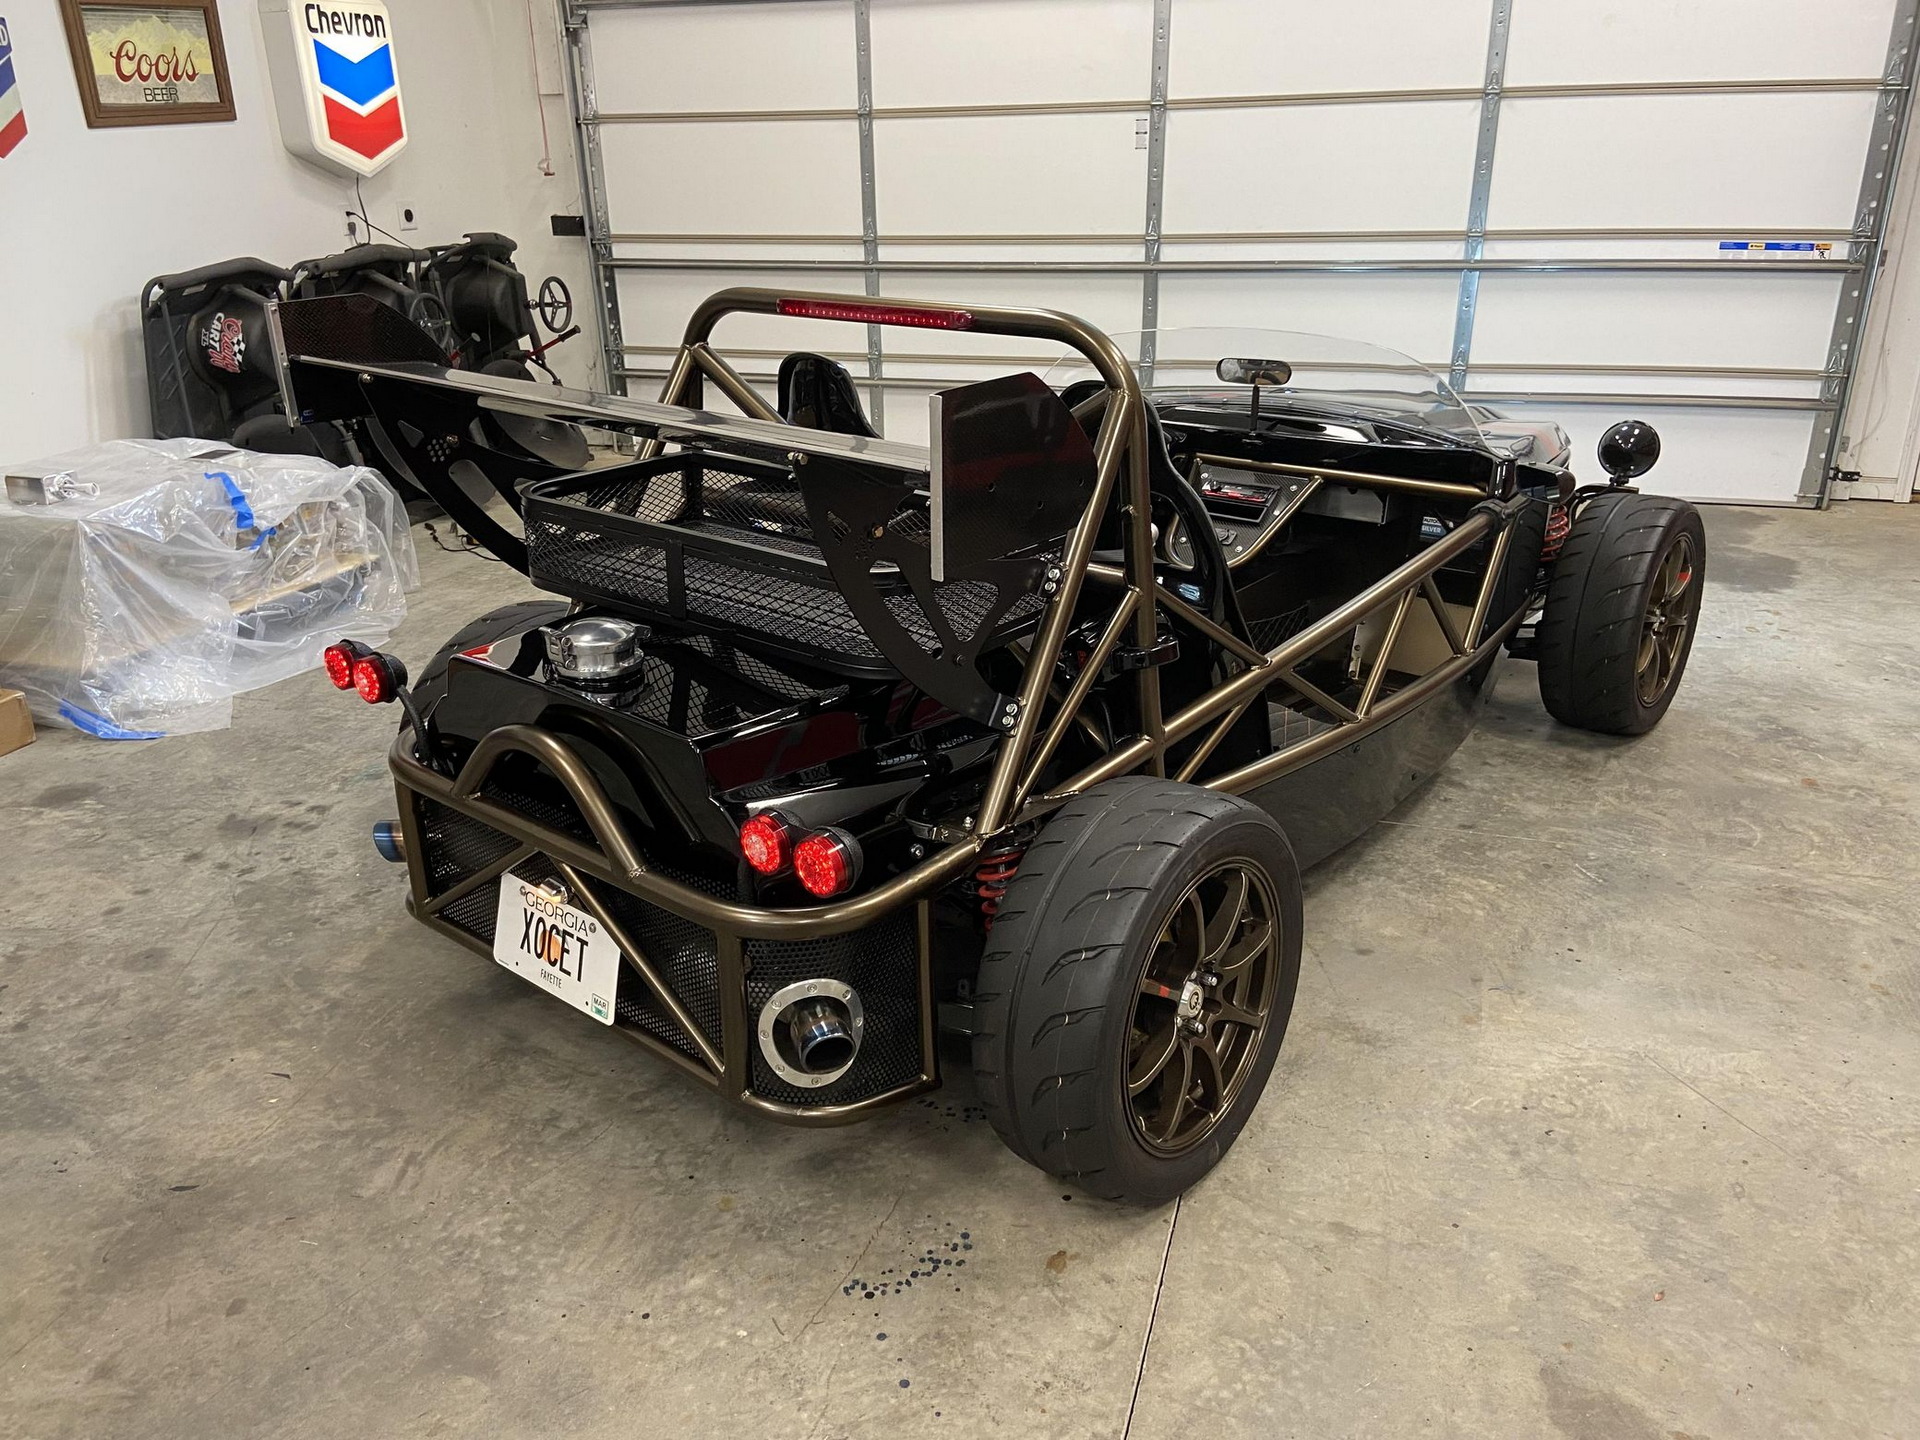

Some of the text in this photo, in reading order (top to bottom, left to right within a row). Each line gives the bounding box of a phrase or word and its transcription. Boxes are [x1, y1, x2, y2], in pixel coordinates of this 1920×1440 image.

[305, 3, 386, 38] Chevron
[109, 40, 199, 82] Coors
[143, 87, 179, 102] BEER
[209, 312, 224, 351] CART
[525, 891, 588, 937] GEORGIA
[520, 907, 588, 982] XOCET
[540, 968, 561, 989] FAYETTE
[593, 997, 606, 1010] MAR
